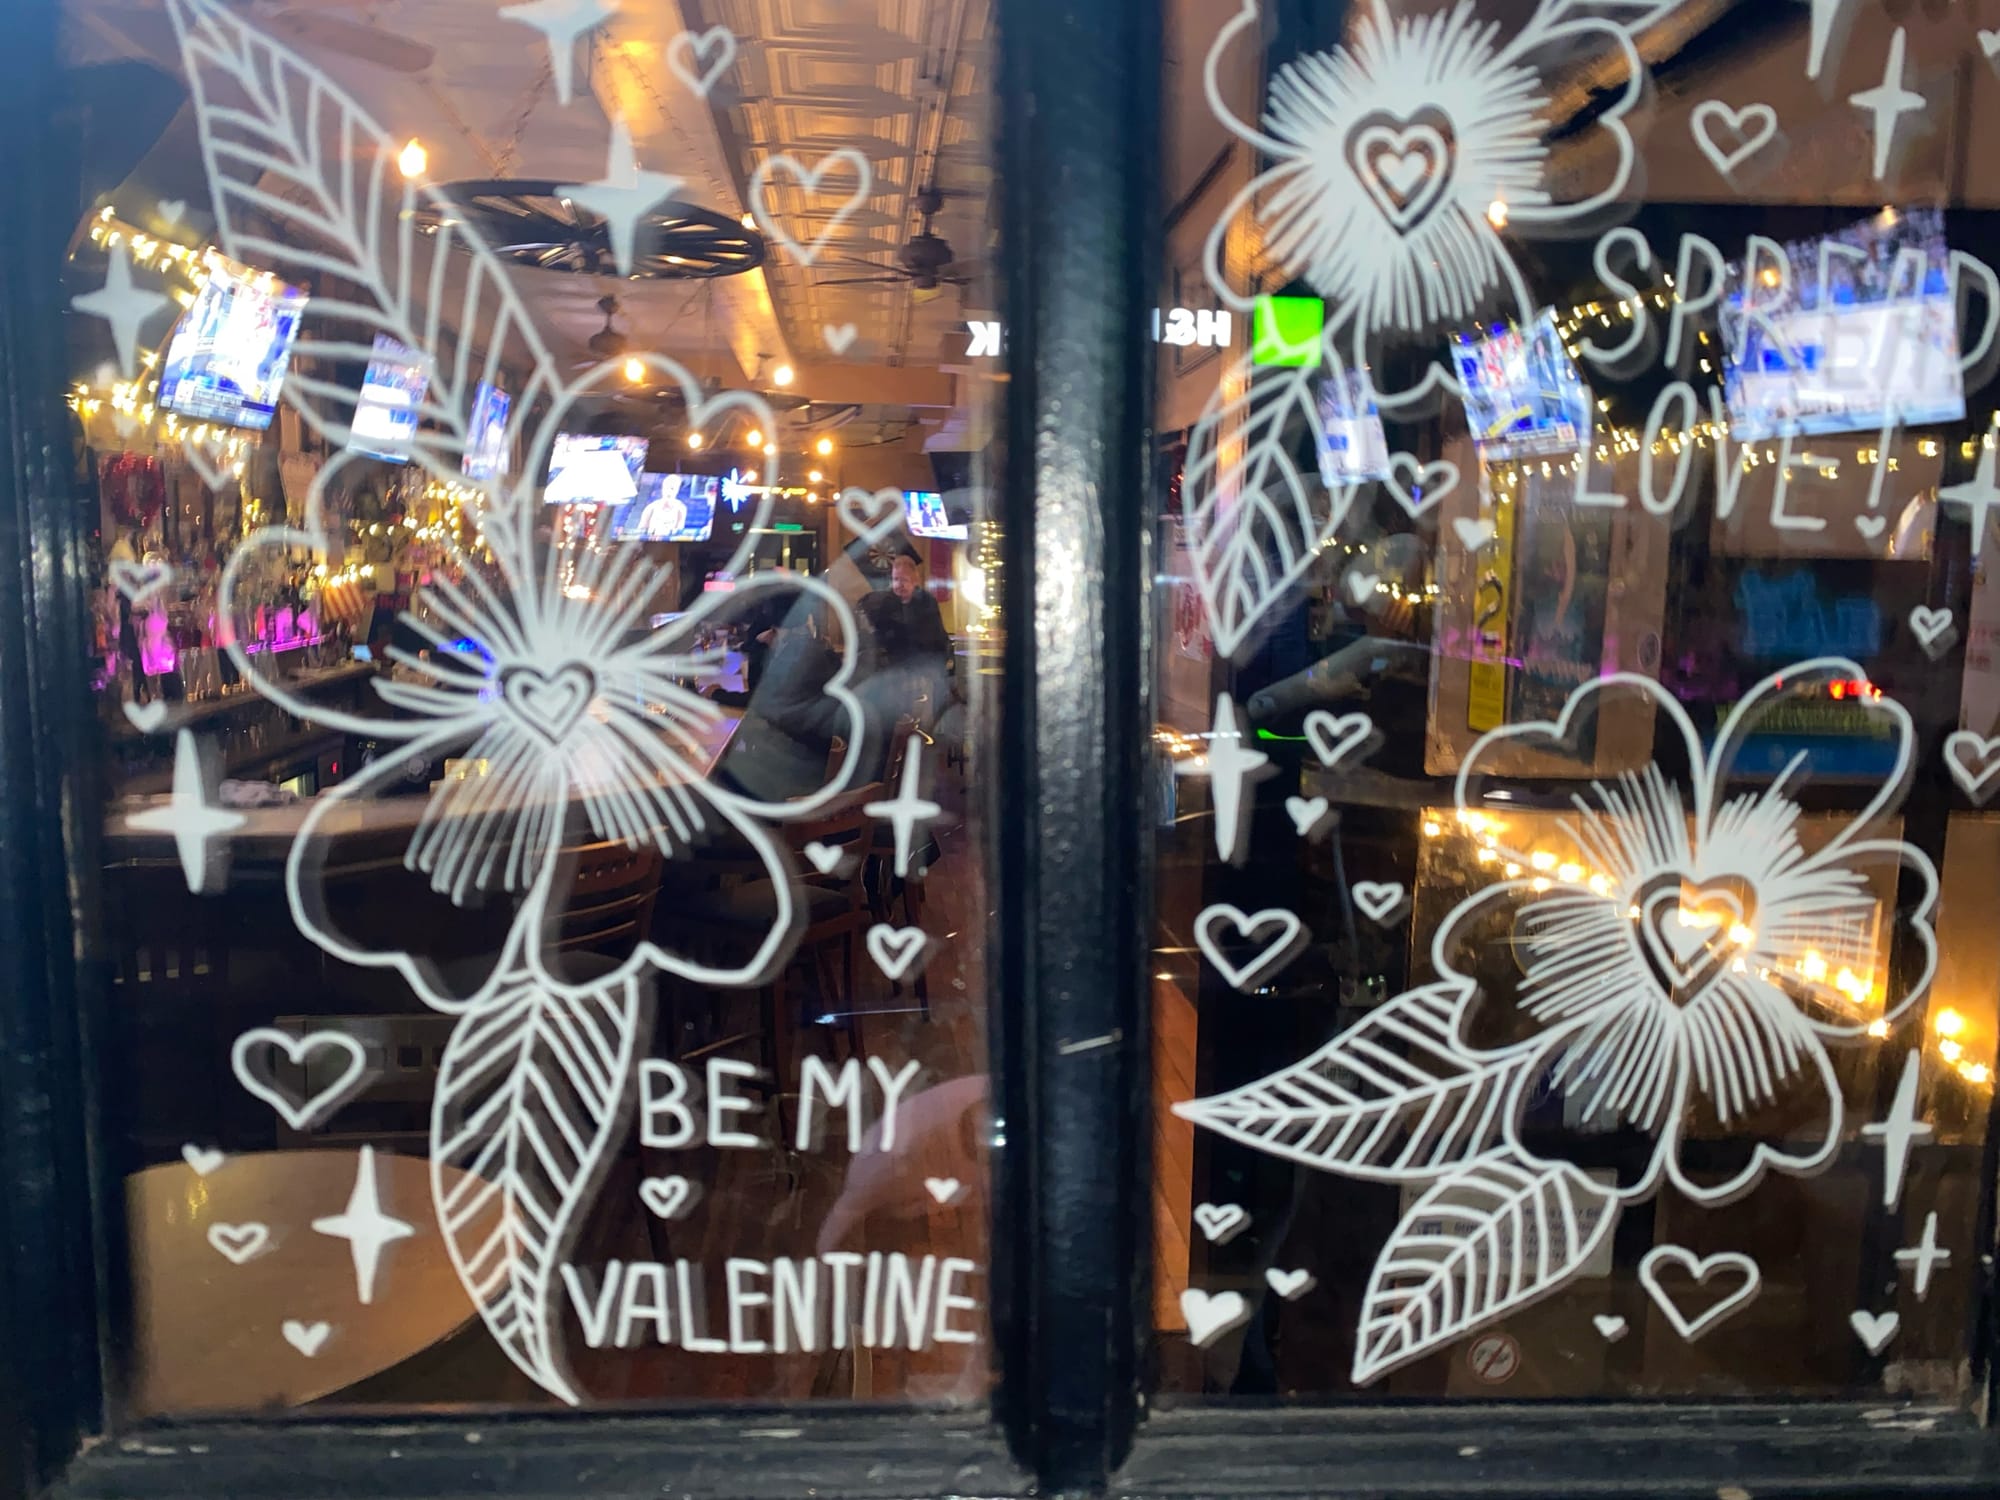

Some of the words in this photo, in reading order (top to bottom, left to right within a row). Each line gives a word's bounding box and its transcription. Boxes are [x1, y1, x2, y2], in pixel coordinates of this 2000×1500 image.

[1580, 226, 2000, 372] SPREAD
[638, 1057, 760, 1149] BE
[797, 1054, 920, 1152] MY
[561, 1252, 978, 1353] VALENTINE
